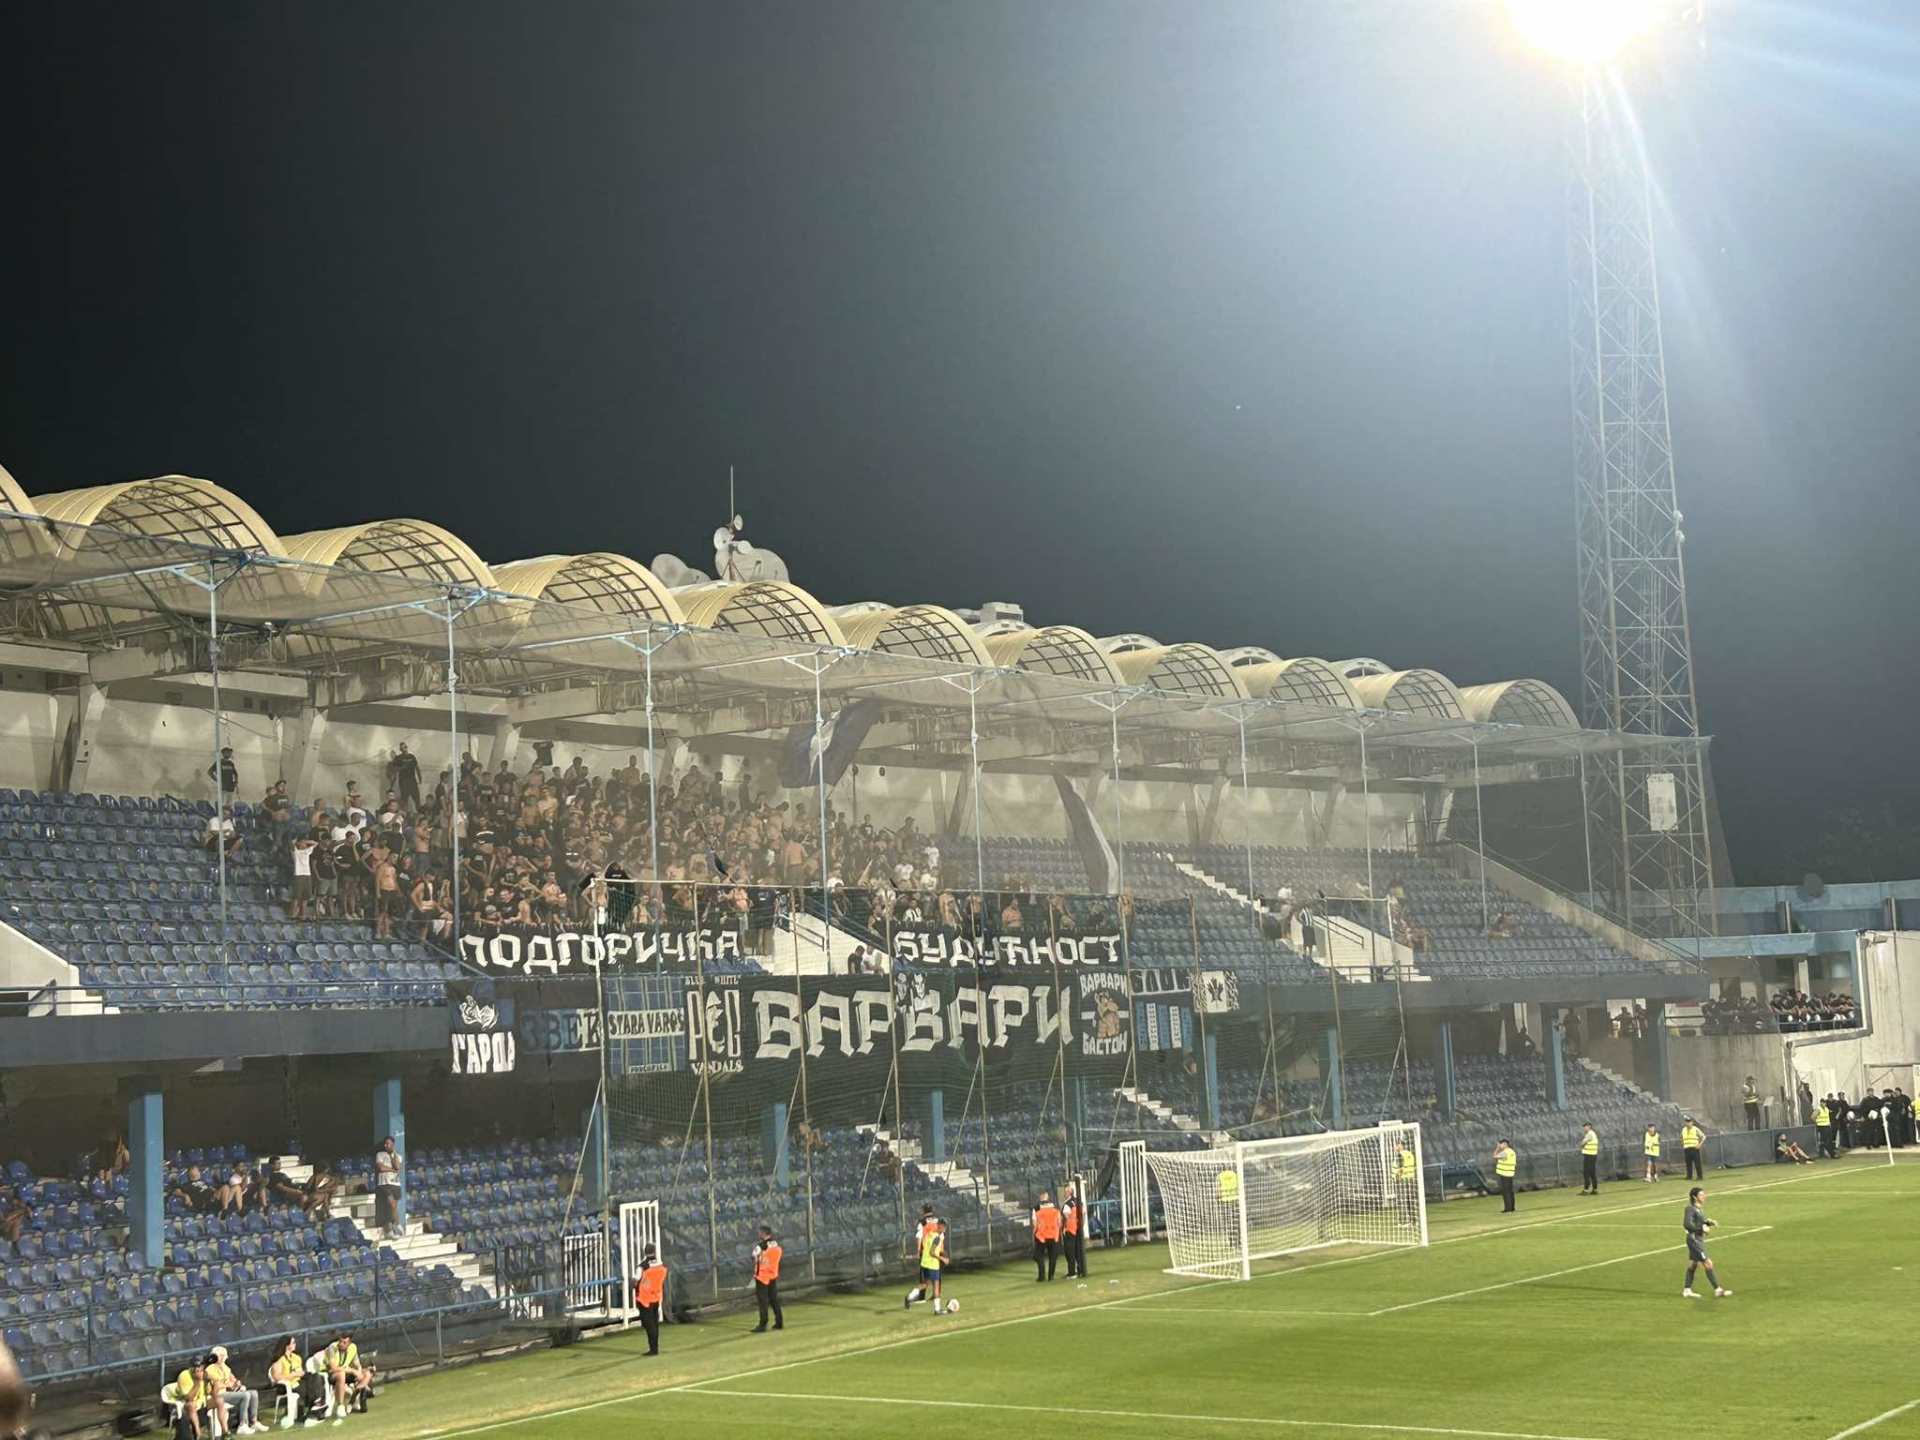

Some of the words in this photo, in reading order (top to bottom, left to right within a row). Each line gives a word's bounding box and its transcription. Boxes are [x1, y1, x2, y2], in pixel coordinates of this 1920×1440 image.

[459, 929, 740, 975] ПОДГОРИЧКА
[893, 930, 1121, 968] БУДУЋНОСТ
[1080, 972, 1128, 999] ВАРВАРИ
[608, 1013, 646, 1036] STARA
[752, 985, 1074, 1060] ВАРВАРИ
[690, 1060, 744, 1076] VANDALS
